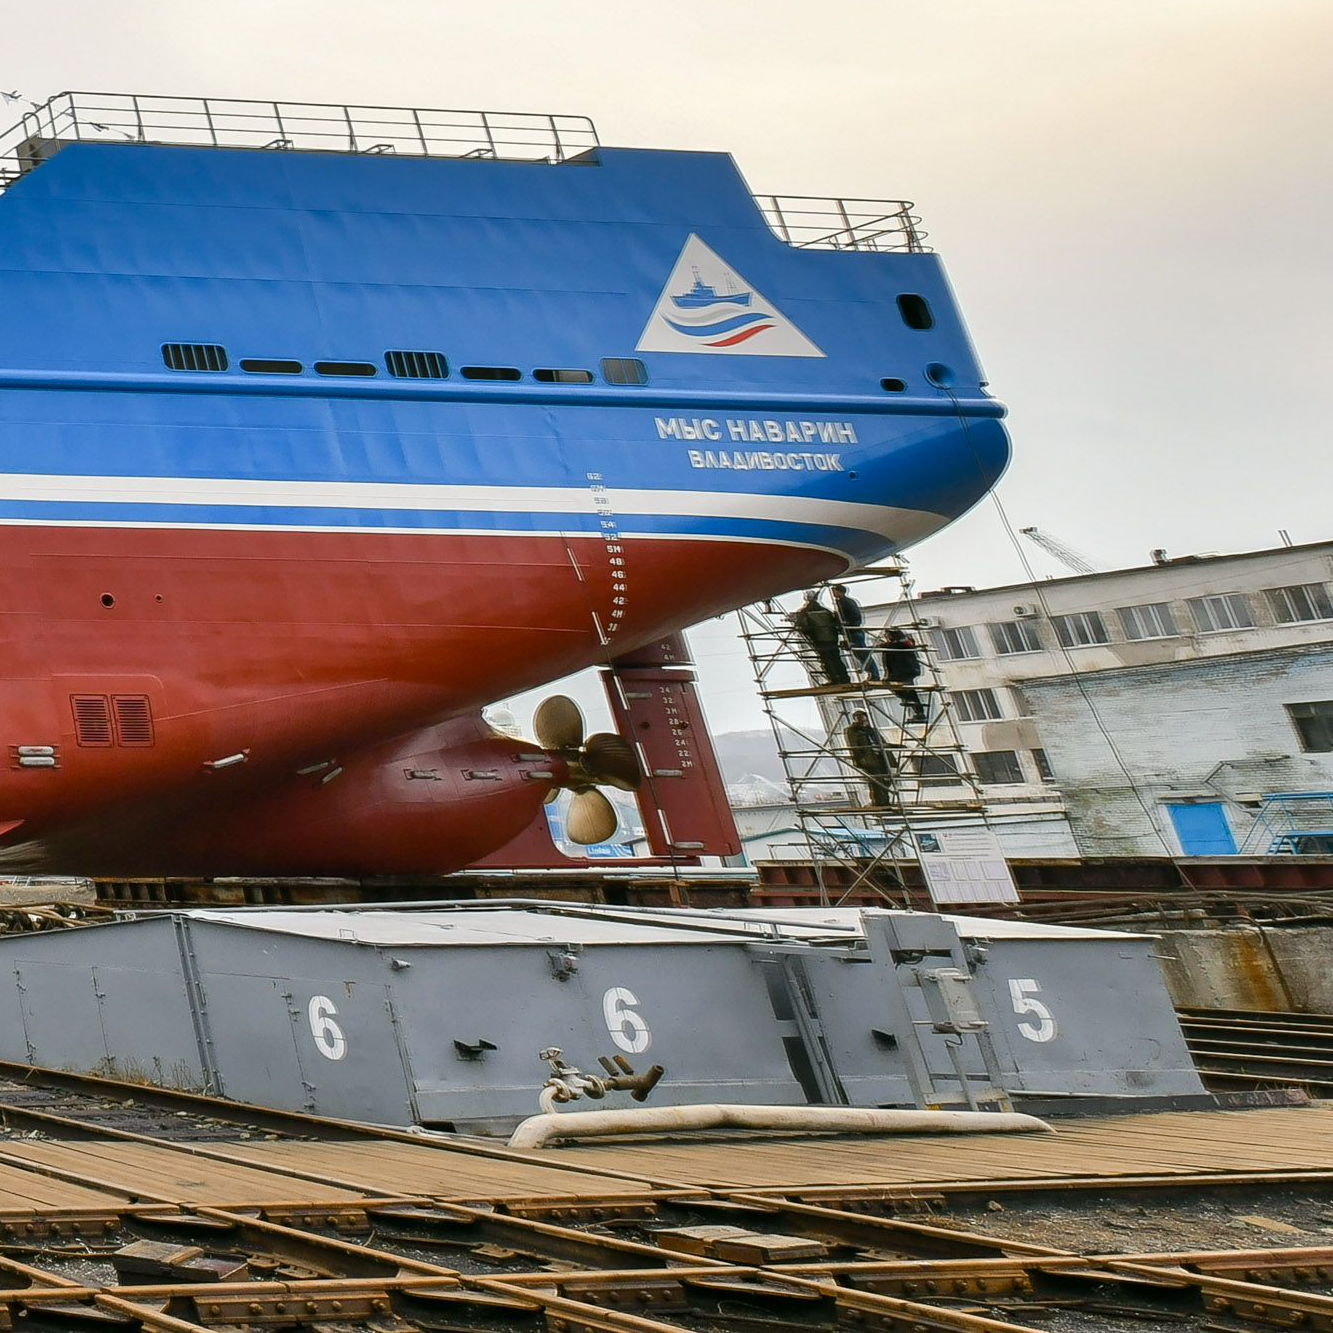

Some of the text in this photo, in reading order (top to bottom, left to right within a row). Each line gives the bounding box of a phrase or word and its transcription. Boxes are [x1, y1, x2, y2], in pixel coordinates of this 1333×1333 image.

[654, 417, 859, 444] МЫС НАВАРИН
[687, 450, 845, 472] ВЛАДИВОСТОК
[611, 570, 624, 579] 46
[613, 583, 625, 592] 44
[613, 597, 625, 605] 42
[603, 987, 650, 1053] 6
[1008, 979, 1055, 1042] 5
[308, 995, 346, 1060] 6
